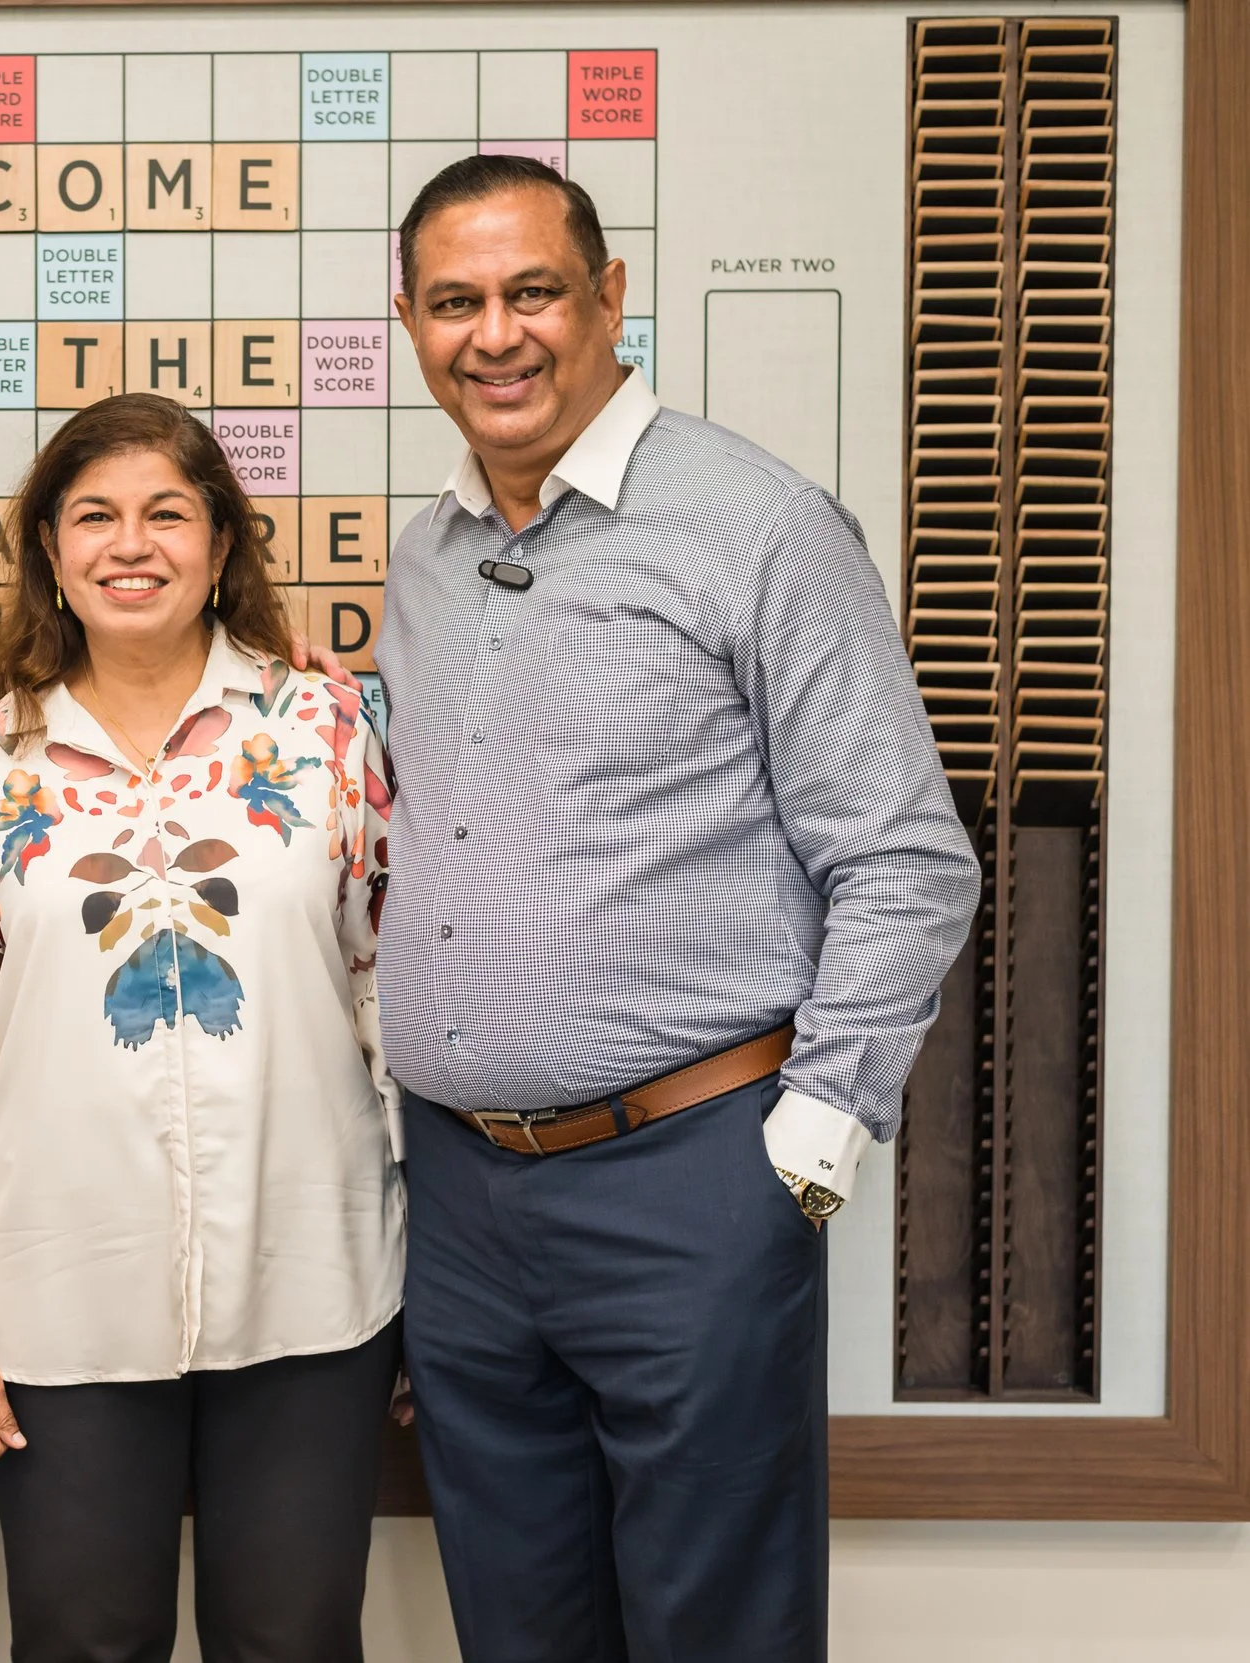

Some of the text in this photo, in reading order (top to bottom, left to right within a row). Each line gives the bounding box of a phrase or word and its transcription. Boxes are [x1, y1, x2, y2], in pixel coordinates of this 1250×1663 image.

[307, 68, 383, 83] DOUBLE
[580, 66, 644, 81] TRIPLE
[311, 89, 379, 104] LETTER
[582, 87, 642, 102] WORD
[314, 110, 376, 125] SCORE
[581, 108, 643, 124] SCORE
[42, 248, 118, 263] DOUBLE
[711, 258, 836, 273] PLAYER TWO
[46, 269, 114, 284] LETTER
[49, 290, 111, 305] SCORE
[307, 335, 382, 350] DOUBLE
[63, 335, 276, 389] THE
[315, 356, 374, 371] WORD
[313, 377, 375, 392] SCORE
[218, 424, 295, 440] DOUBLE
[226, 445, 286, 460] WORD
[237, 466, 287, 481] CORE
